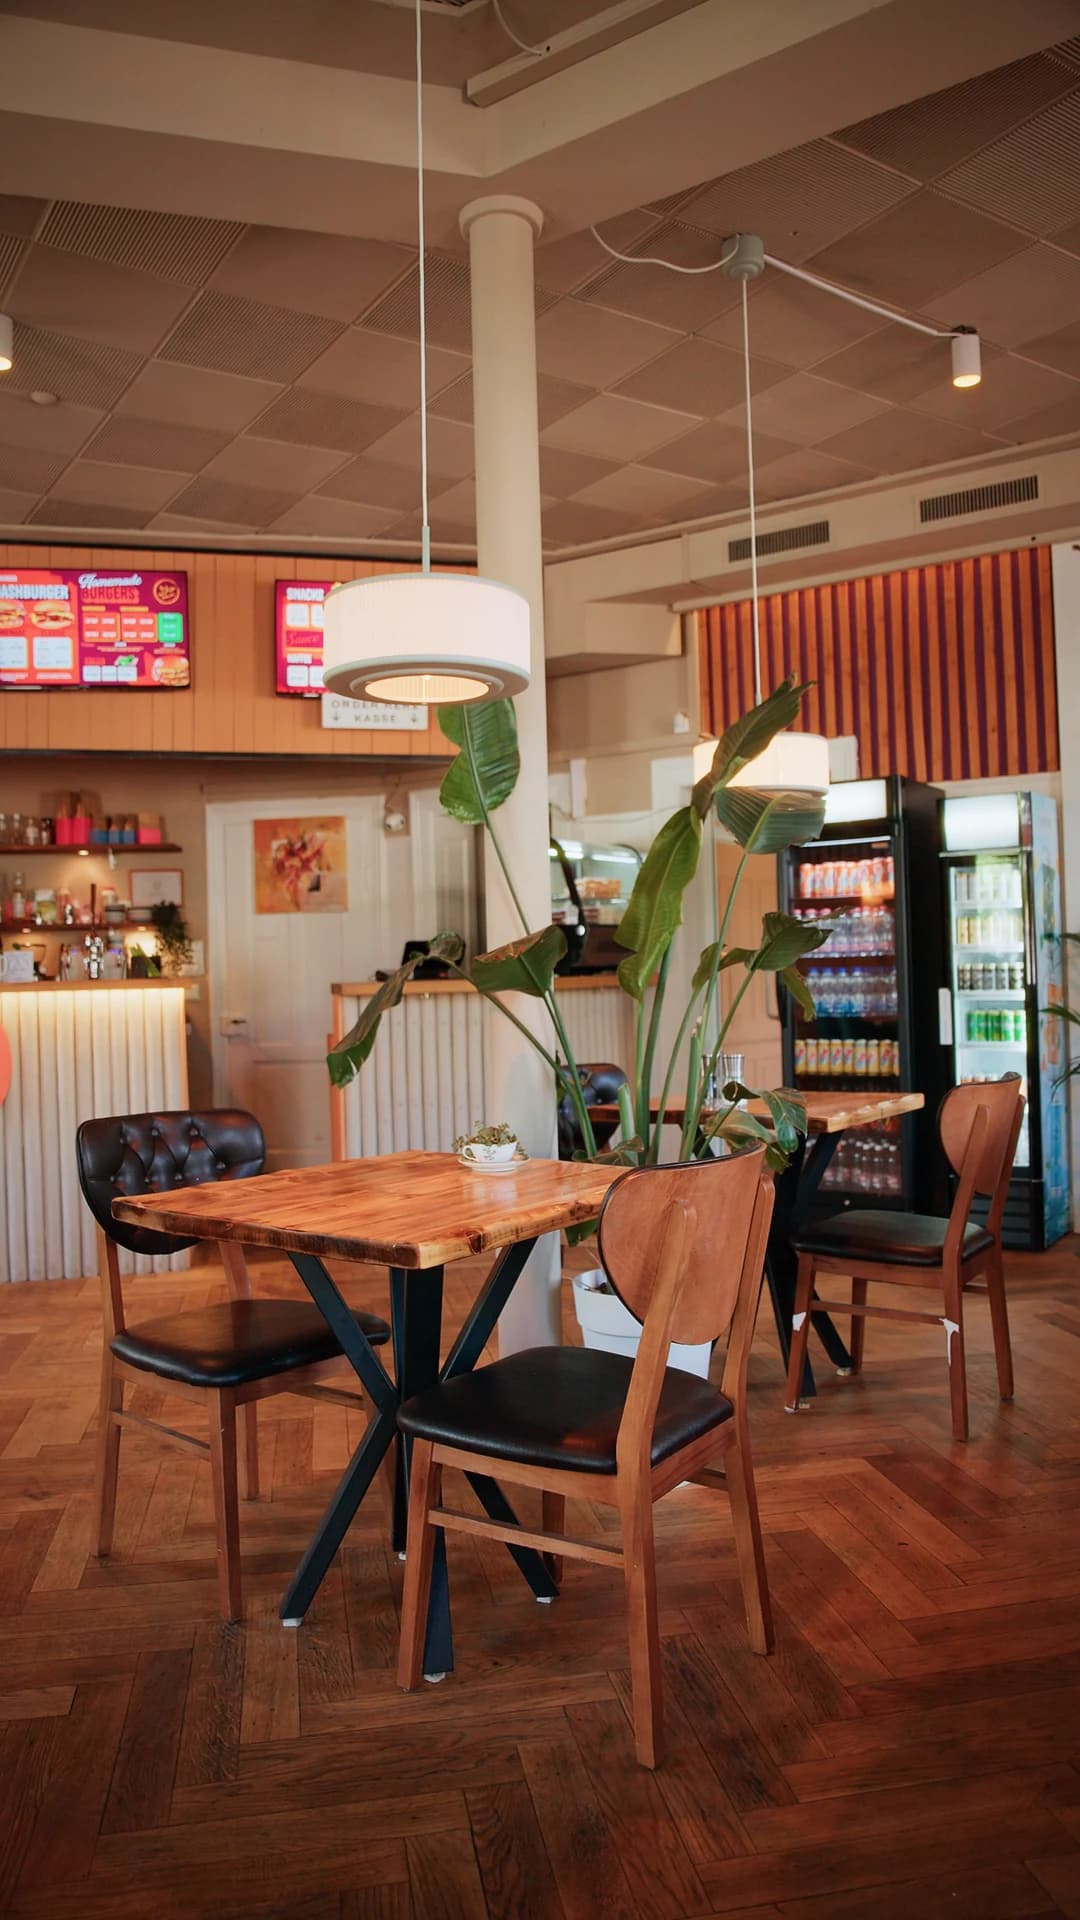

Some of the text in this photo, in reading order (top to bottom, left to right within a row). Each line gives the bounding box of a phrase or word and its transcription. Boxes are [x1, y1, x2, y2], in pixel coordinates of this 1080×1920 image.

[79, 573, 142, 589] Homemade
[0, 584, 69, 600] ASHBURGER
[82, 587, 137, 600] BURGERS
